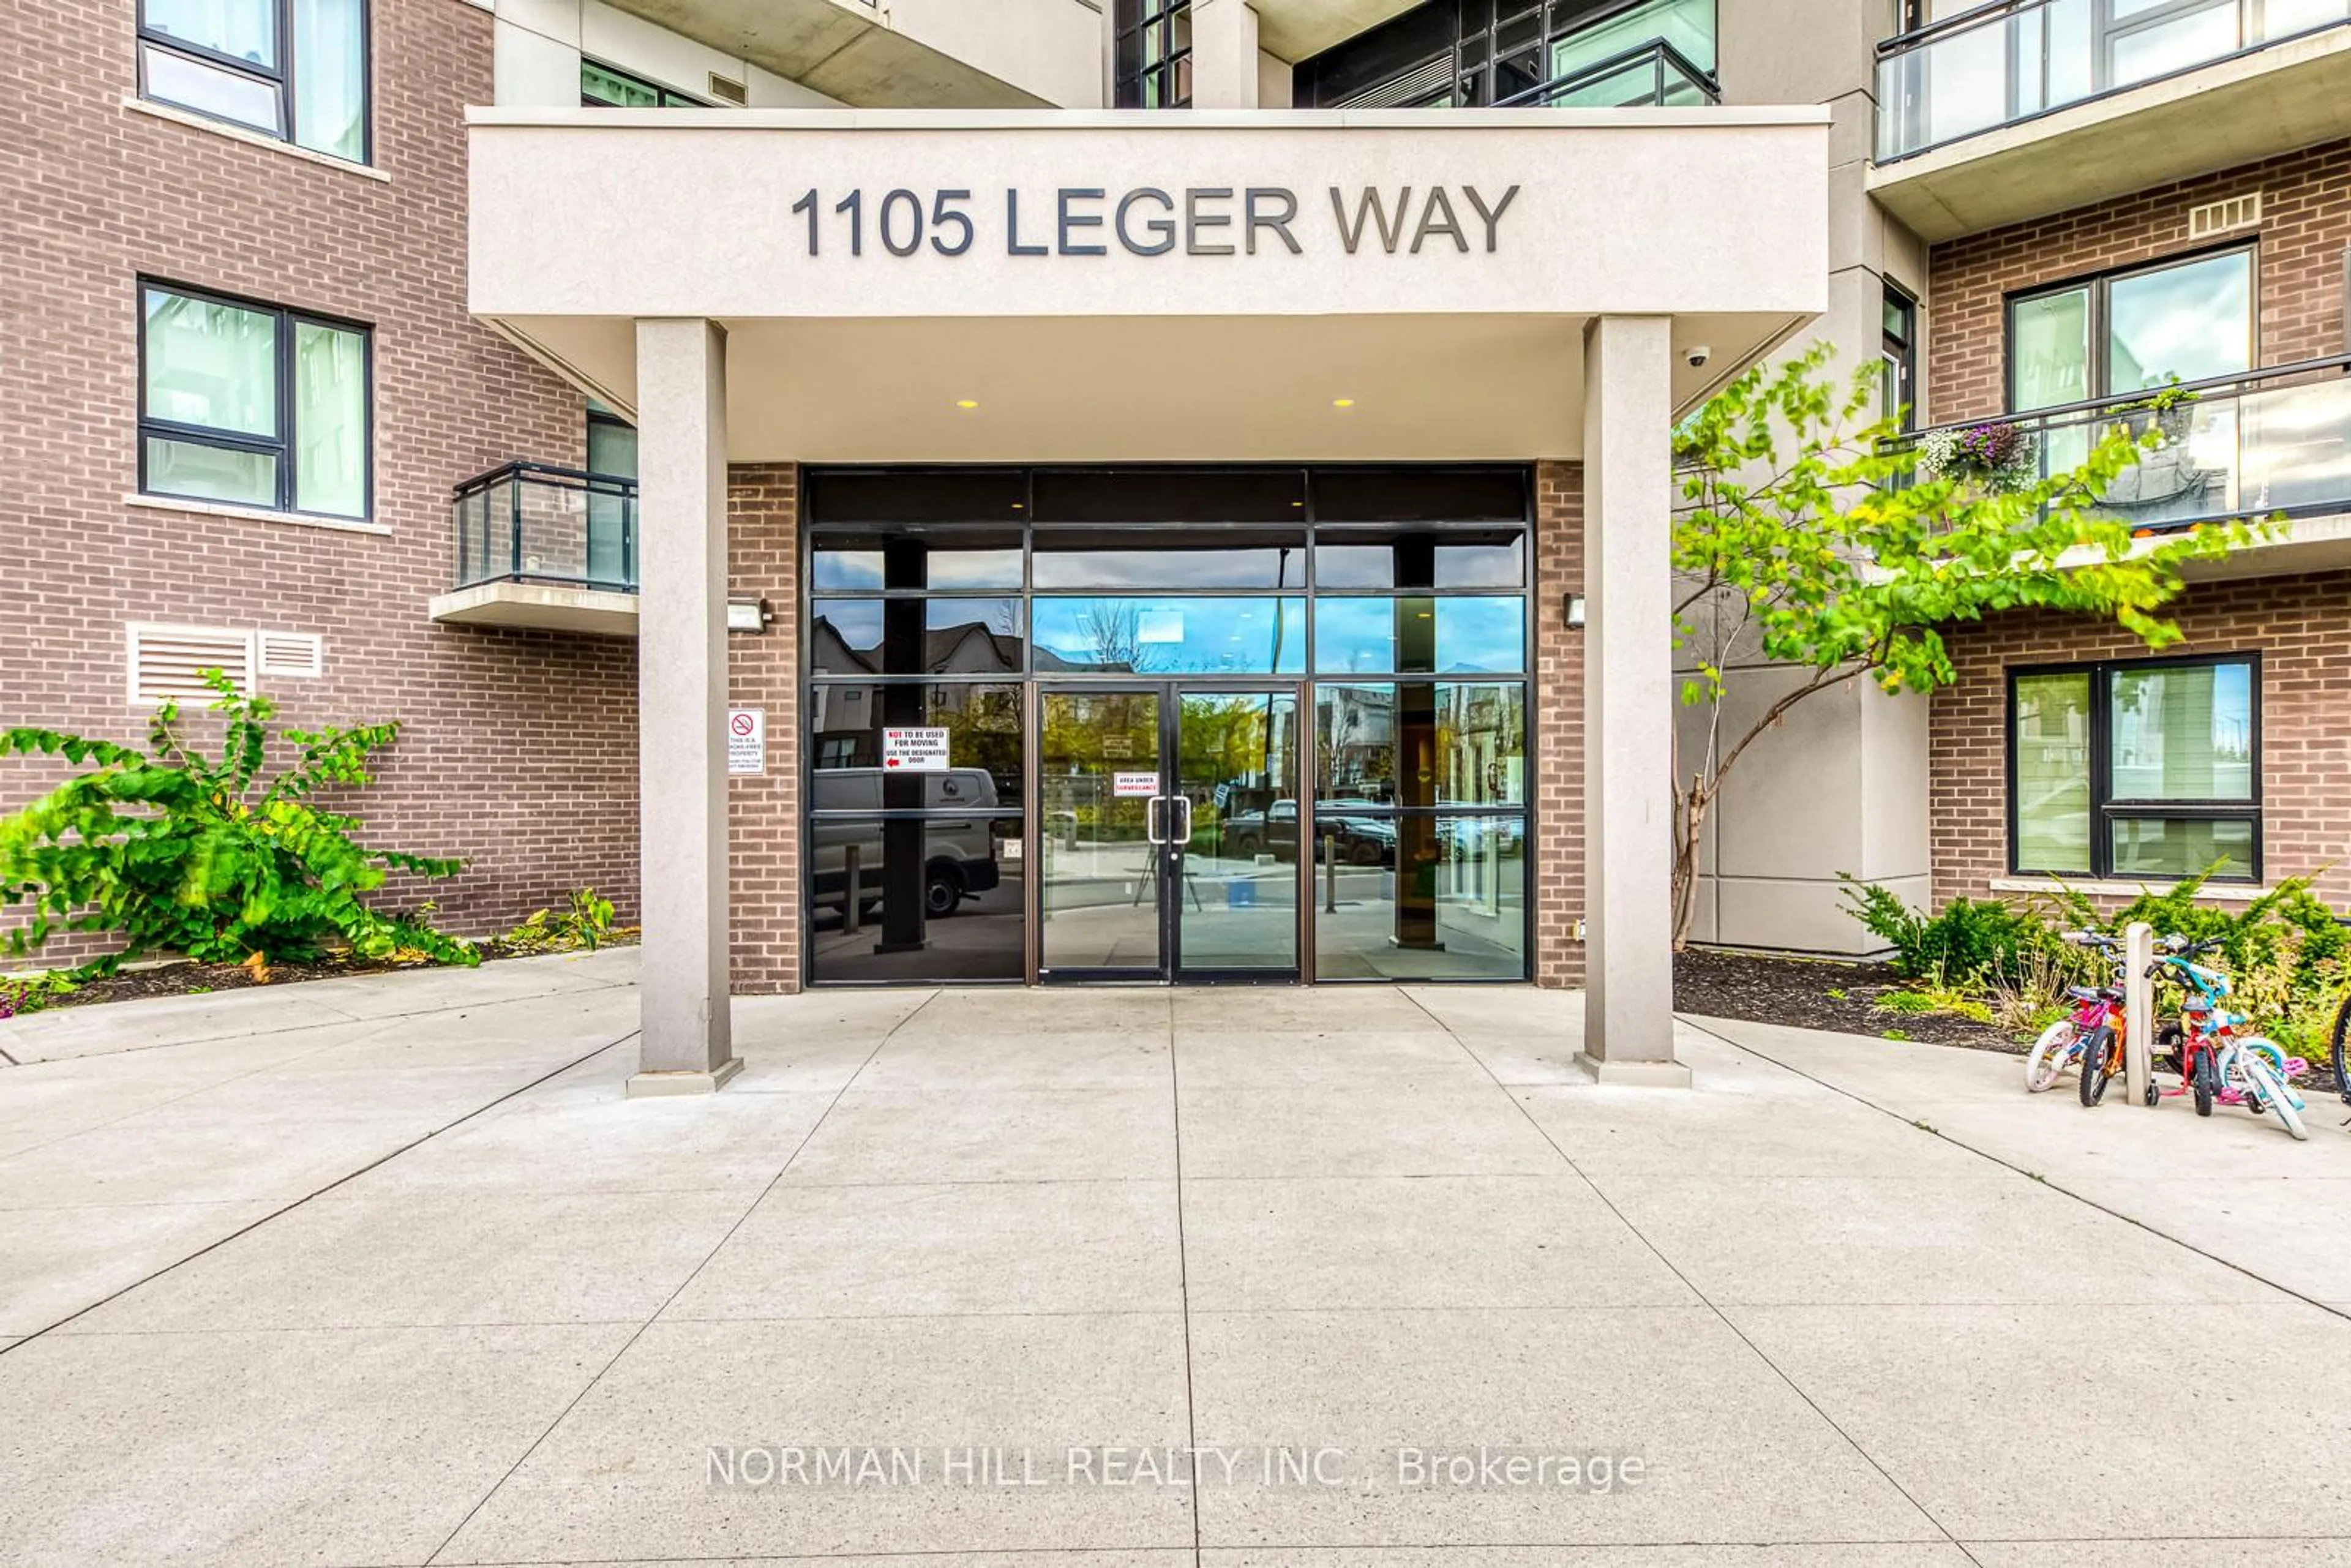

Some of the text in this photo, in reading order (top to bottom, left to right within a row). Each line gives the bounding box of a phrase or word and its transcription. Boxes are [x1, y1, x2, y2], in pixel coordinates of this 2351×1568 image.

[792, 184, 1520, 258] 1105 LEGER WAY
